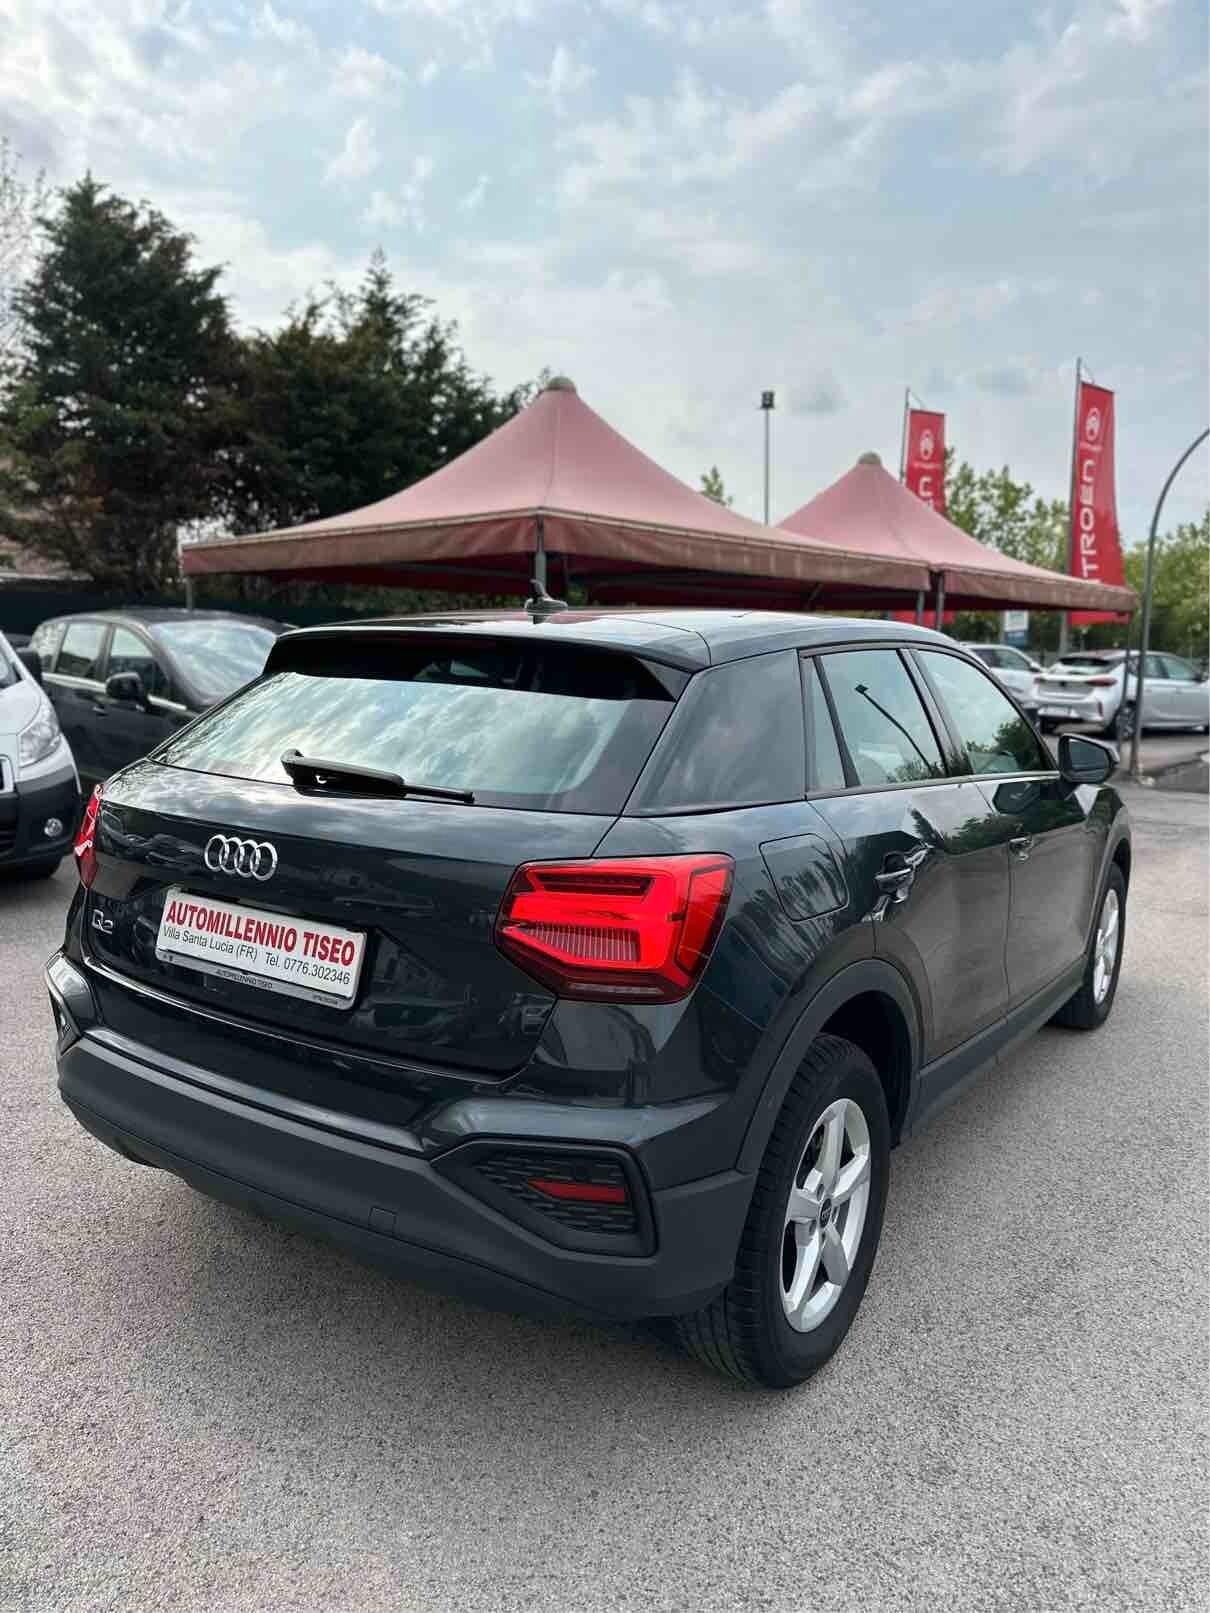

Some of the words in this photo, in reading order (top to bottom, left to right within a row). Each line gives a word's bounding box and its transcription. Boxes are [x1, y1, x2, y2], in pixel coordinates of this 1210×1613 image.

[91, 909, 114, 935] Q2
[166, 900, 298, 953] AUTOMILLENNIO
[303, 931, 355, 967] TISEO
[163, 925, 181, 940] Villa
[182, 929, 208, 948] Santa
[209, 936, 234, 954] Lucia
[235, 943, 258, 963] (FR)
[265, 951, 281, 968] Tel.
[283, 957, 351, 985] 0776.302346
